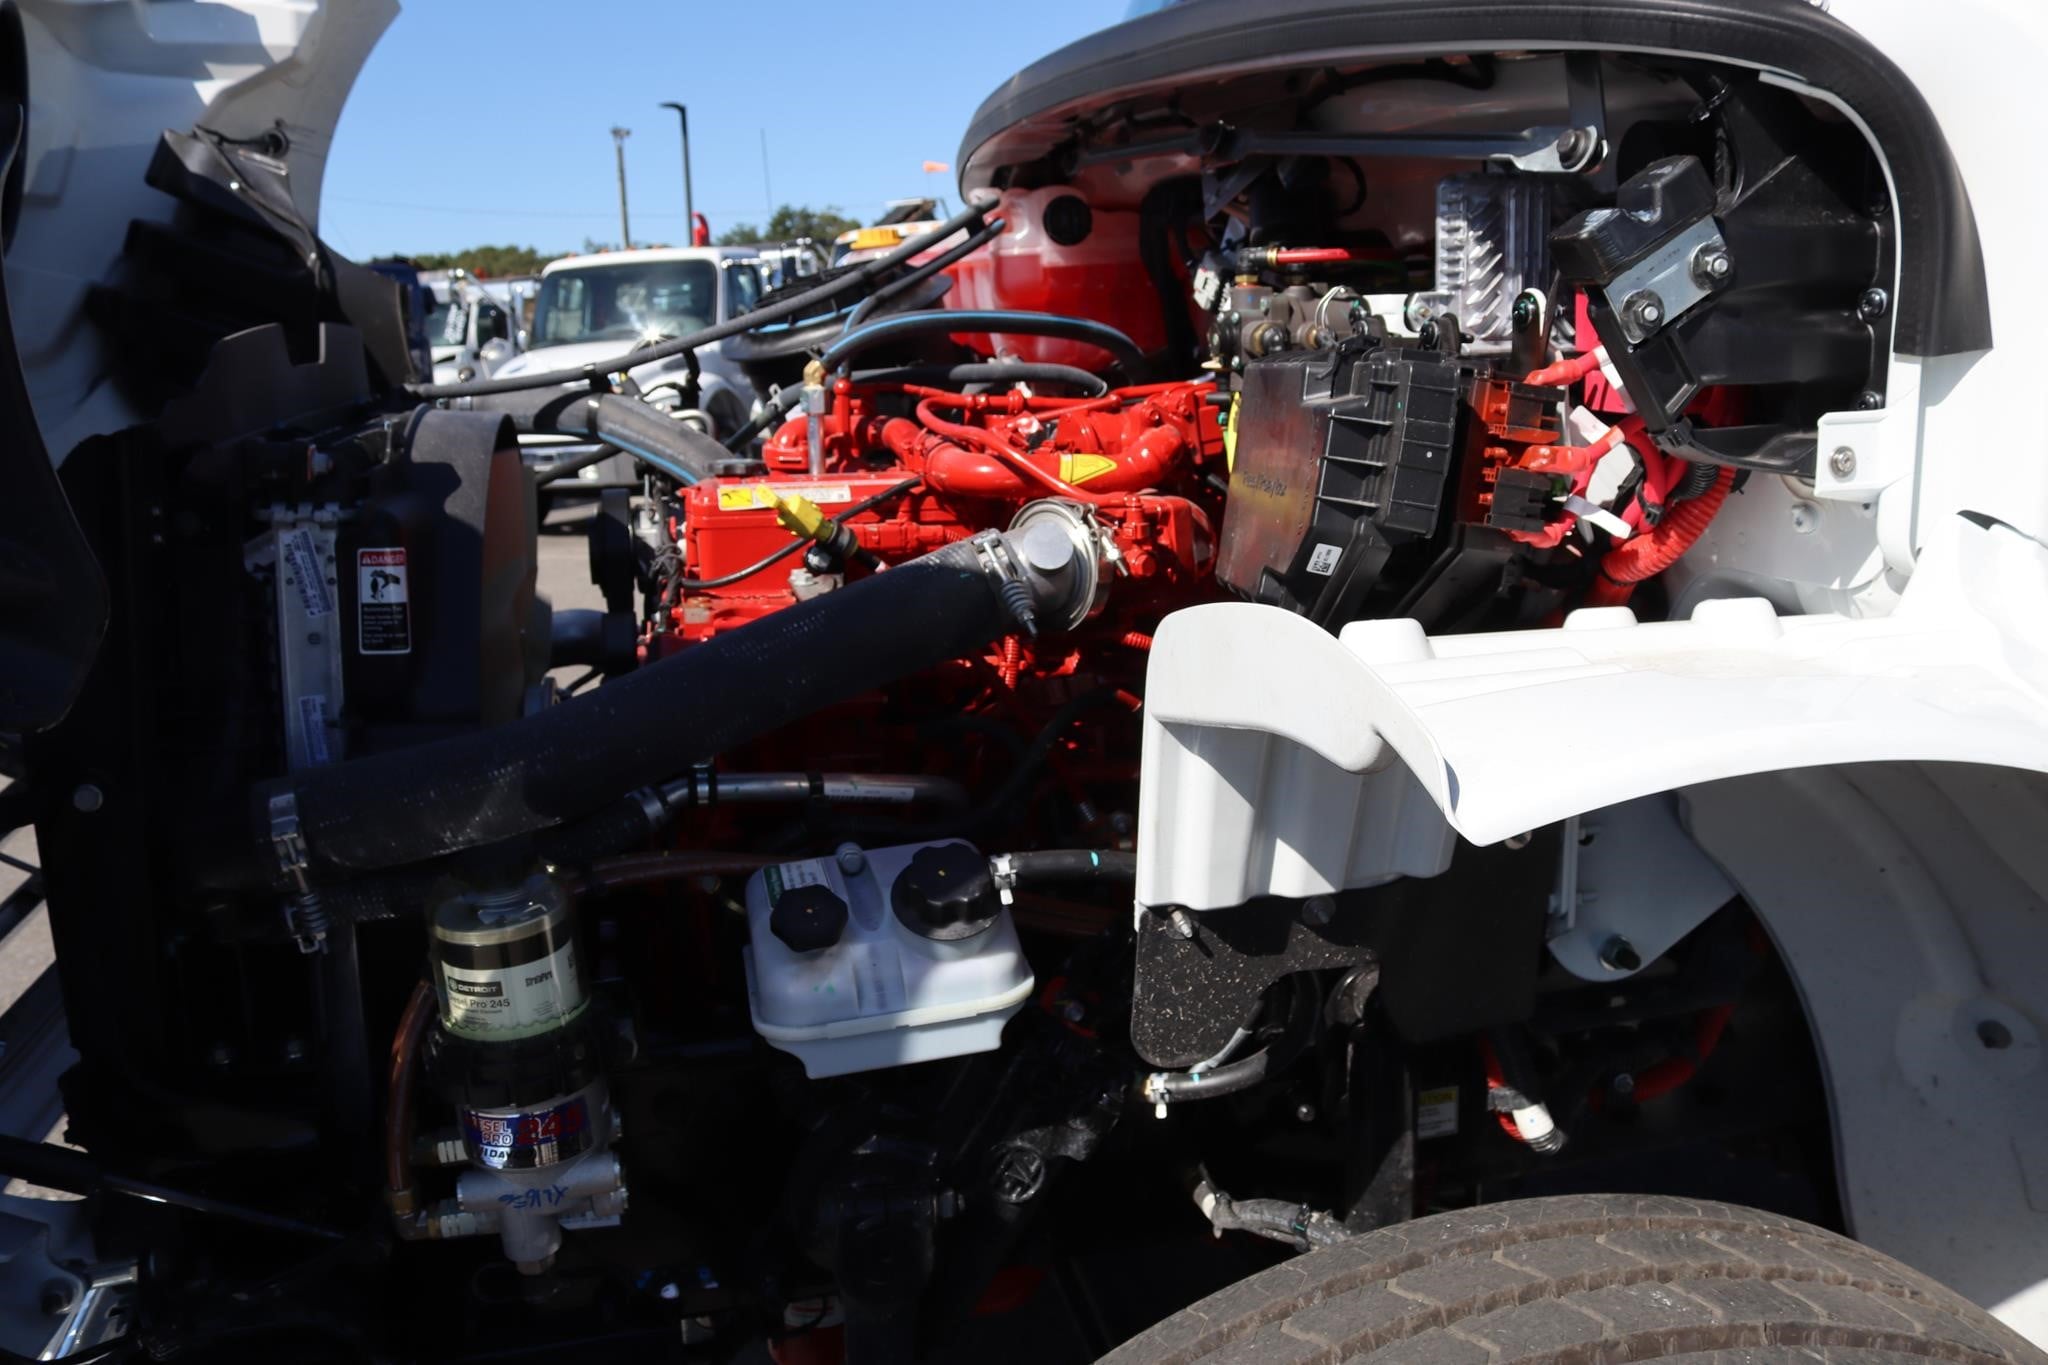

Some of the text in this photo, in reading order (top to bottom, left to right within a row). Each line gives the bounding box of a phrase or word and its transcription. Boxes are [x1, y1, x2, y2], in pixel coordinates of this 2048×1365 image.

[458, 984, 496, 993] DETROIT
[470, 999, 487, 1008] Pro
[489, 998, 511, 1008] 245
[482, 1131, 514, 1147] PRO
